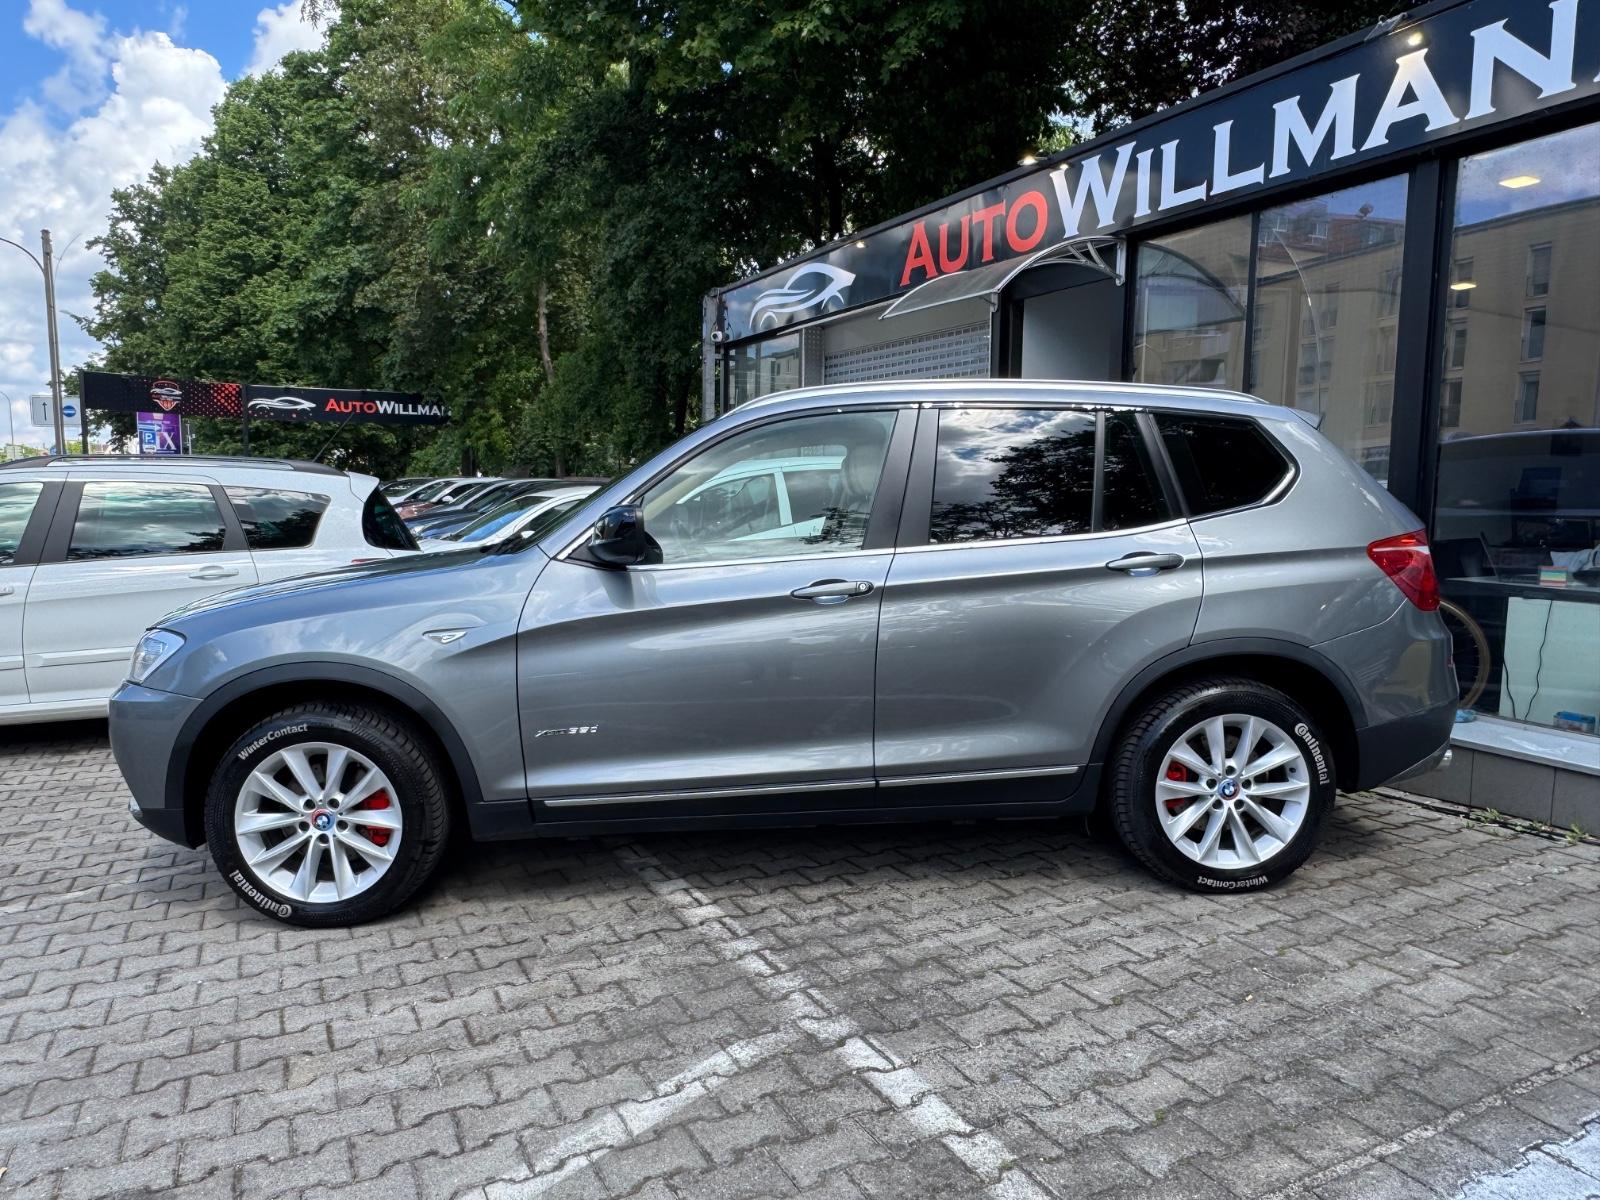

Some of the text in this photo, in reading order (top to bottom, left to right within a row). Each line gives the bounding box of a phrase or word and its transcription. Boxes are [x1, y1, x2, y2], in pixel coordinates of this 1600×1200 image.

[900, 0, 1600, 286] AUTOWILLMAN
[237, 723, 308, 761] WinterContact
[1294, 722, 1330, 785] Continental
[228, 869, 293, 918] Continental
[1197, 875, 1268, 889] WinterContact
